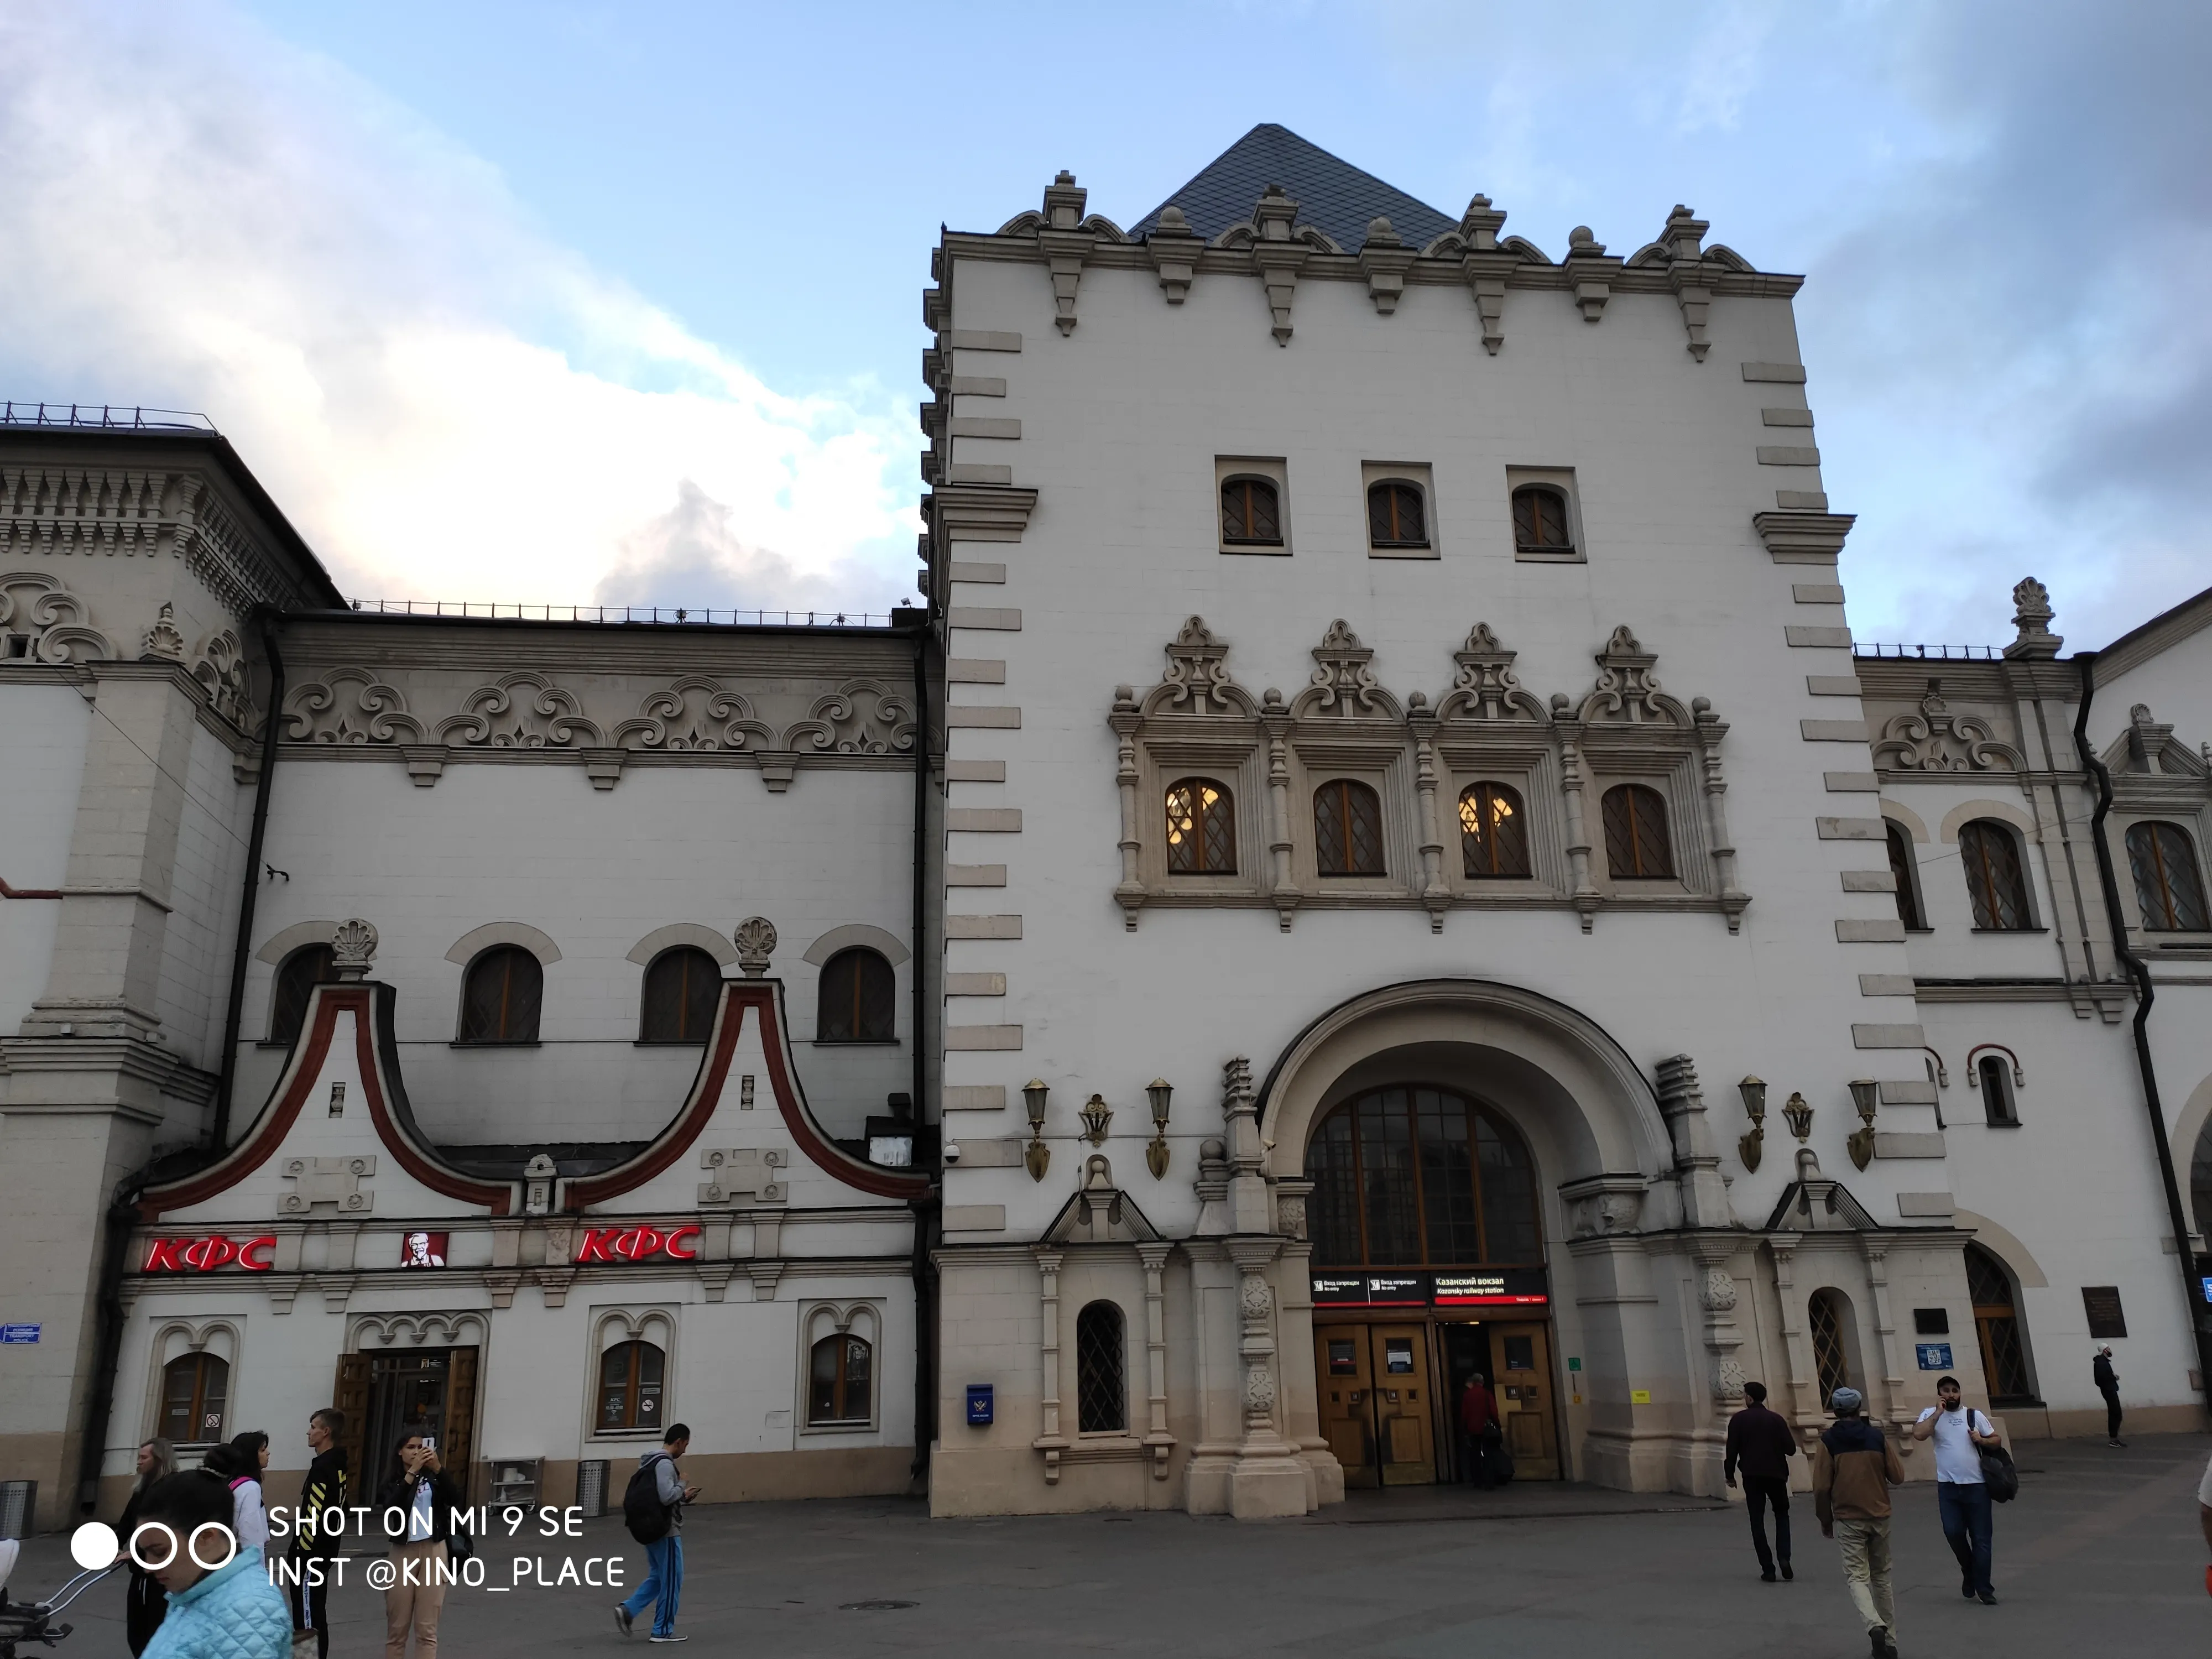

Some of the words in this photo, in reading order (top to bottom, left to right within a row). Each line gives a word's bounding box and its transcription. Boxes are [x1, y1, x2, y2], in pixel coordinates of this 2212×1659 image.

[142, 1235, 277, 1271] КФС
[575, 1225, 701, 1262] КФС
[1436, 1277, 1477, 1285] Казанский
